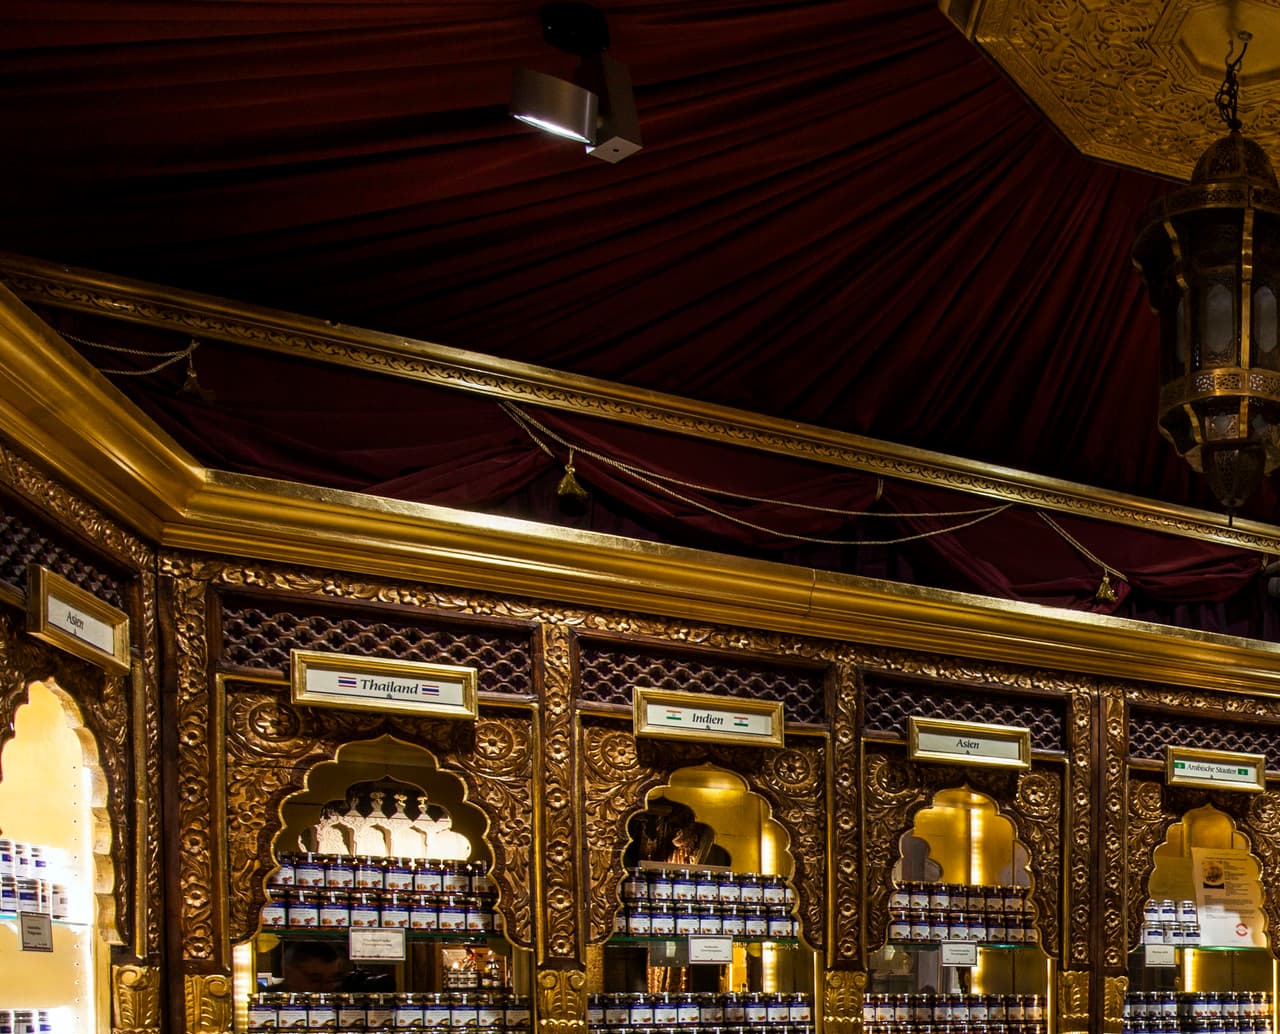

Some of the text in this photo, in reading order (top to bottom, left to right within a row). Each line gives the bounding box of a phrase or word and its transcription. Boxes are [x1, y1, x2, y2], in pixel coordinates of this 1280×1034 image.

[66, 611, 85, 631] Asien
[360, 679, 419, 695] Thailand
[692, 713, 724, 725] Indien
[956, 739, 979, 749] Asien
